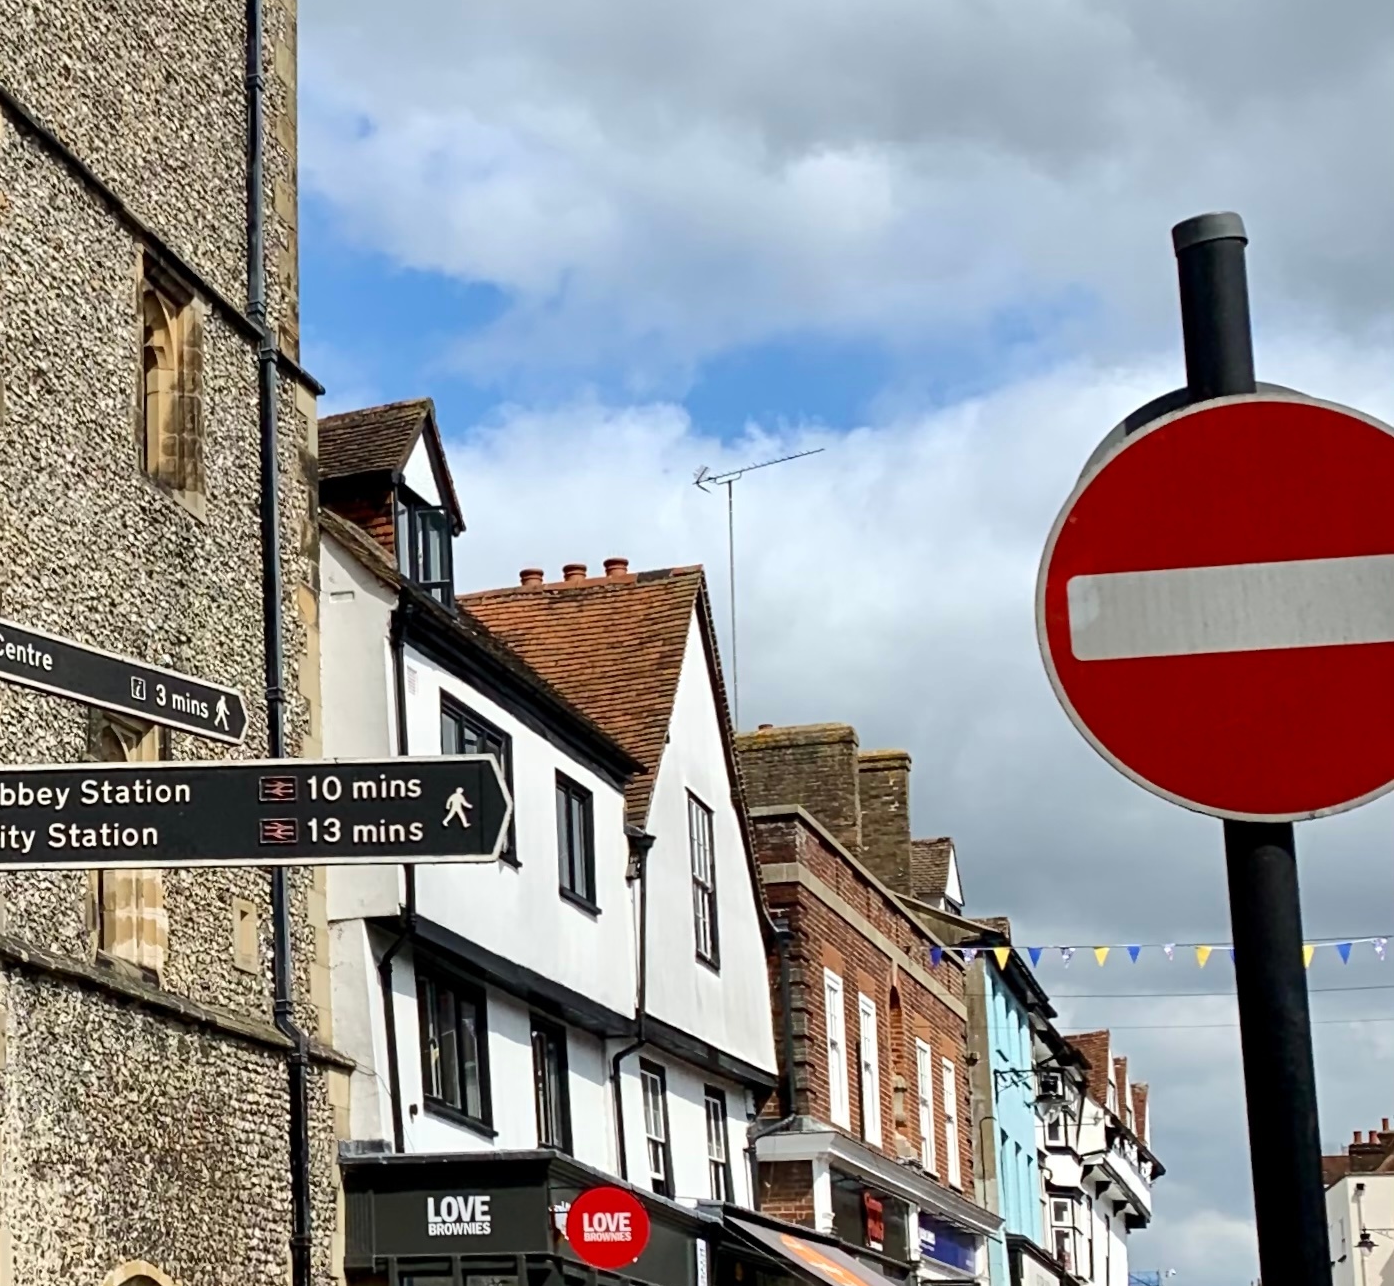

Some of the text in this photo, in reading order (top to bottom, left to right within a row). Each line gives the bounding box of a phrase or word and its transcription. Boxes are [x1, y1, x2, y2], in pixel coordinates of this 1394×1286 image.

[156, 683, 167, 707] 3
[172, 691, 209, 719] mins
[80, 779, 191, 805] Station
[307, 775, 342, 801] 10
[352, 774, 422, 800] mins
[47, 822, 158, 848] Station
[308, 817, 341, 843] 13
[353, 818, 424, 844] mins
[427, 1195, 491, 1223] LOVE
[582, 1212, 632, 1233] LOVE
[428, 1221, 491, 1236] BROWNIES
[583, 1231, 632, 1243] BROWNIES
